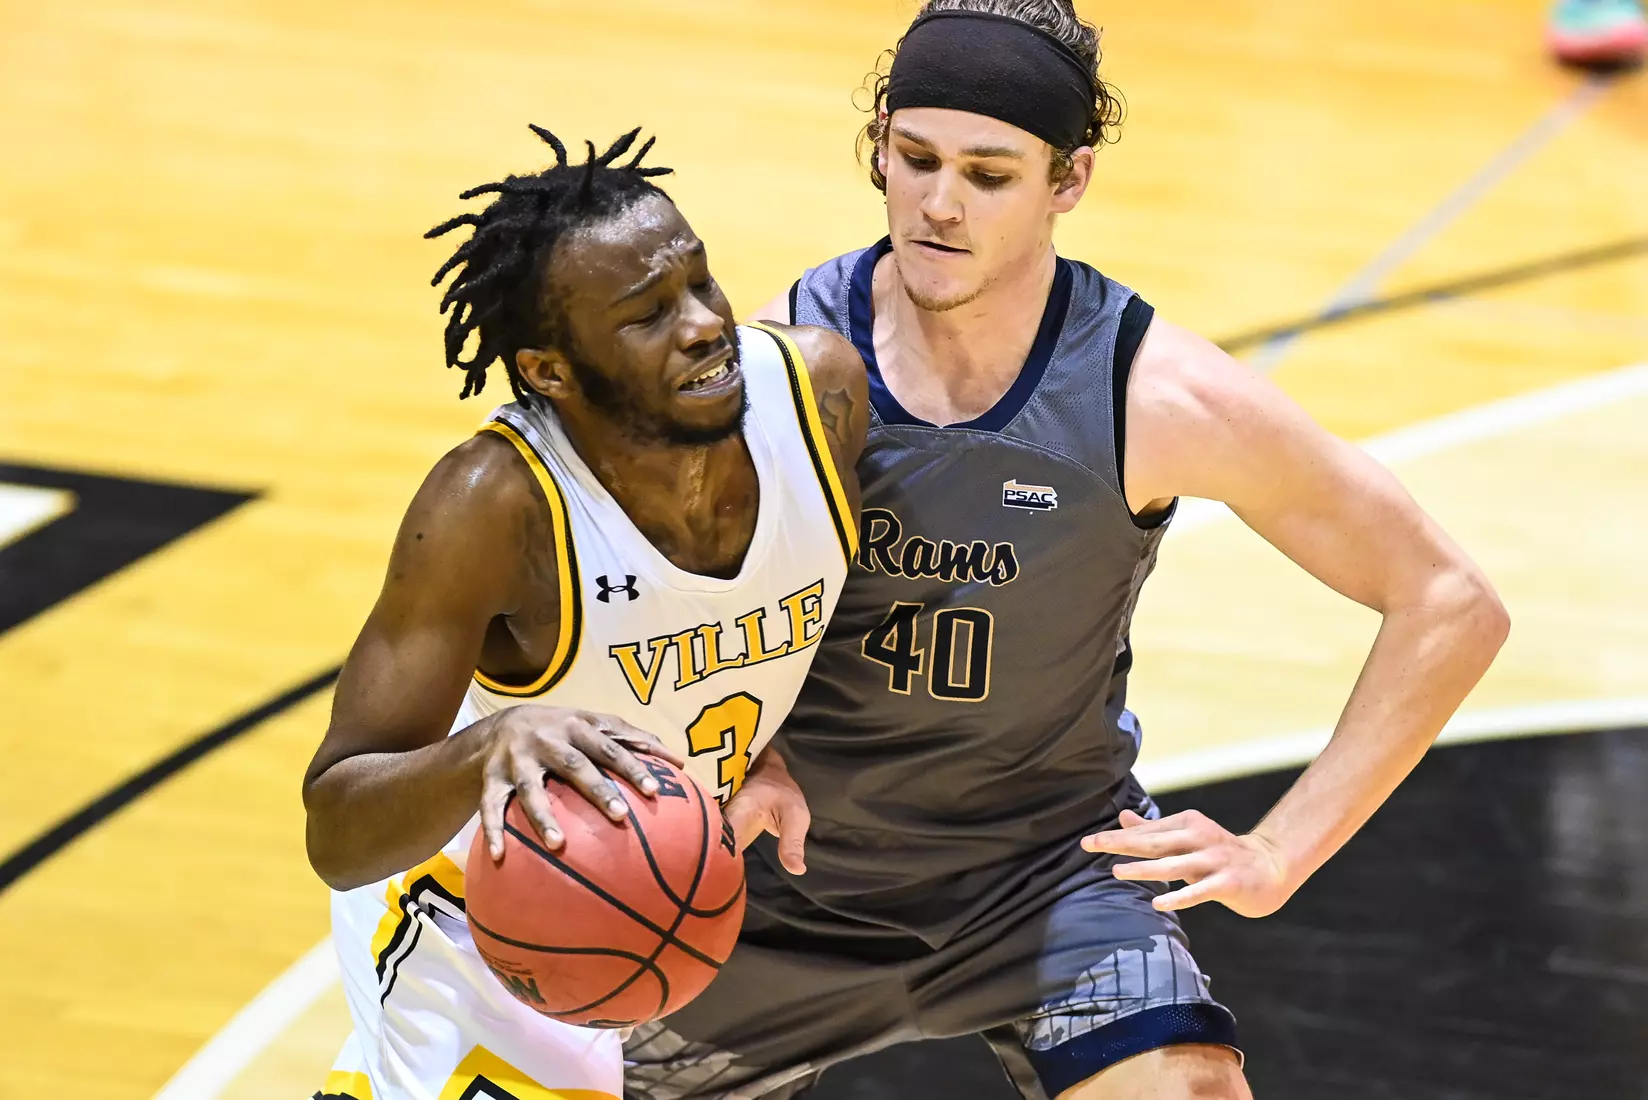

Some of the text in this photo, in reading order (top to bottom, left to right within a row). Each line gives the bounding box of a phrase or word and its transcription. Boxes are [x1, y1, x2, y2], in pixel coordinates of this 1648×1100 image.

[857, 507, 1020, 587] Rams
[1004, 489, 1053, 505] PSAC
[608, 577, 825, 706] VILLE
[861, 600, 995, 703] 40
[685, 690, 764, 807] 3
